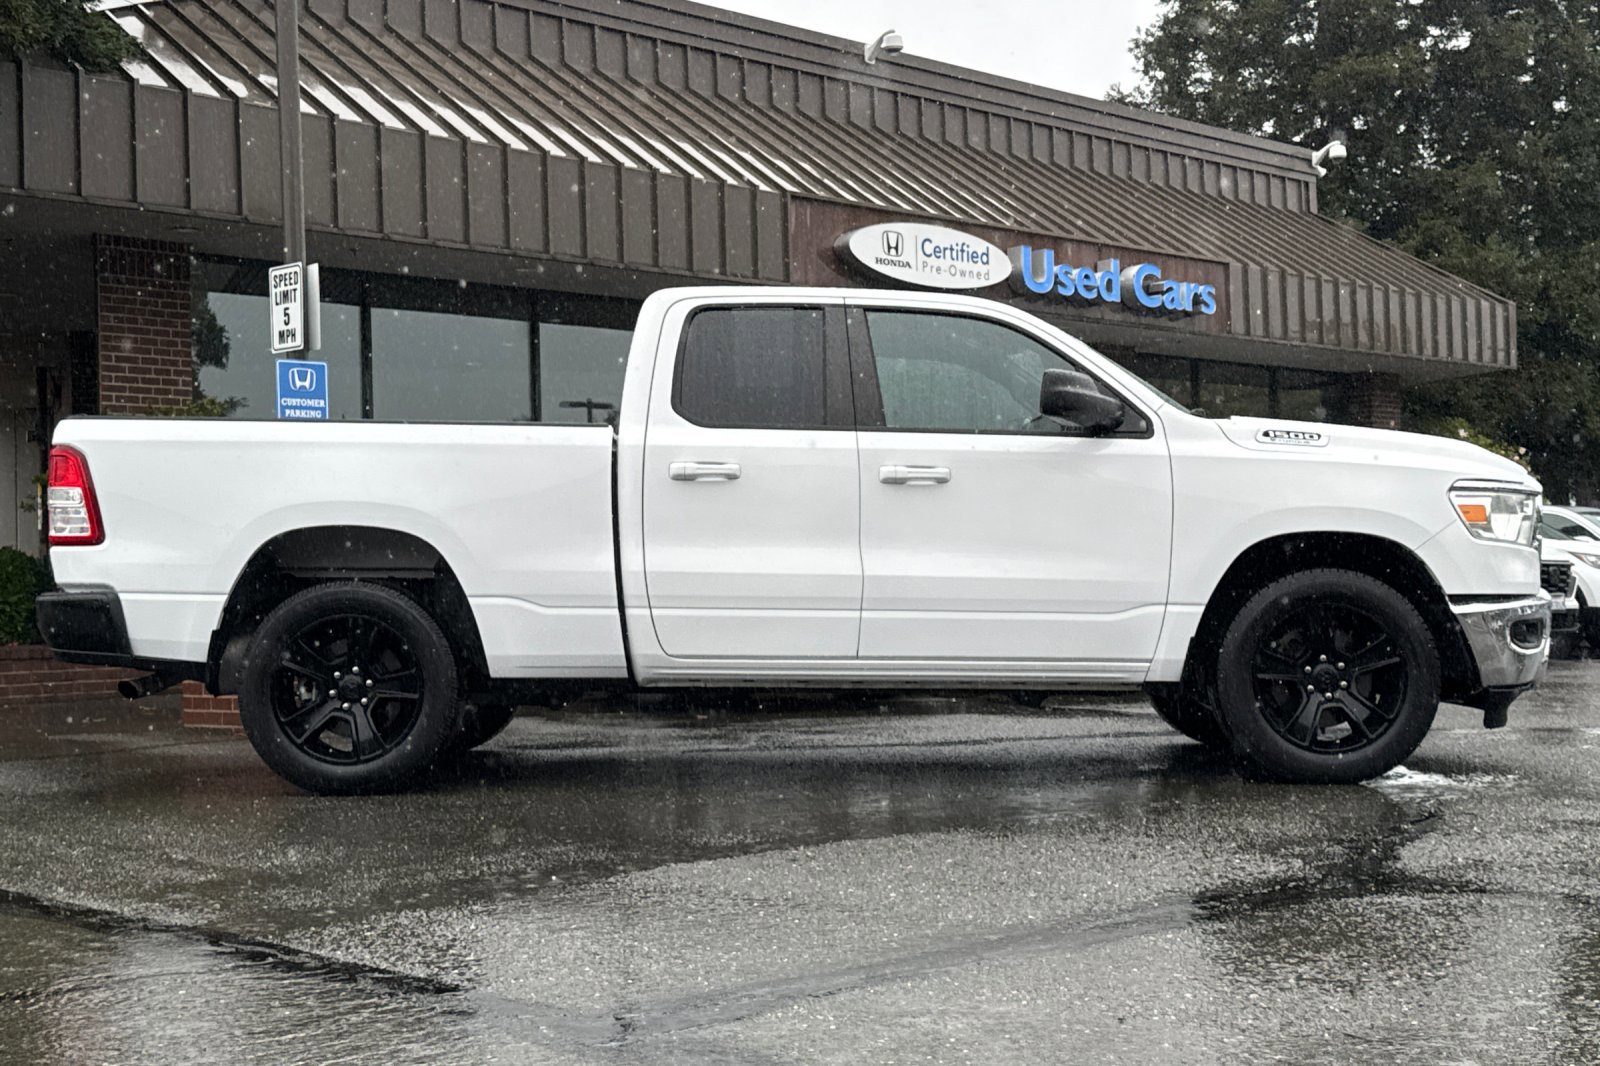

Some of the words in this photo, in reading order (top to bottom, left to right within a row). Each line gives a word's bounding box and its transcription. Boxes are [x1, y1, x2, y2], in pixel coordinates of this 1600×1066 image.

[921, 238, 990, 265] Certified
[875, 257, 912, 269] HONDA
[922, 261, 990, 281] Pre-Owned
[273, 271, 299, 289] SPEED
[1020, 245, 1121, 303] Used
[1133, 263, 1217, 315] Cars
[274, 288, 298, 306] LIMIT
[283, 307, 290, 326] 5
[278, 328, 297, 345] MPH
[281, 397, 326, 408] CUSTOMER
[285, 408, 322, 418] PARKING
[1266, 430, 1320, 441] 1500
